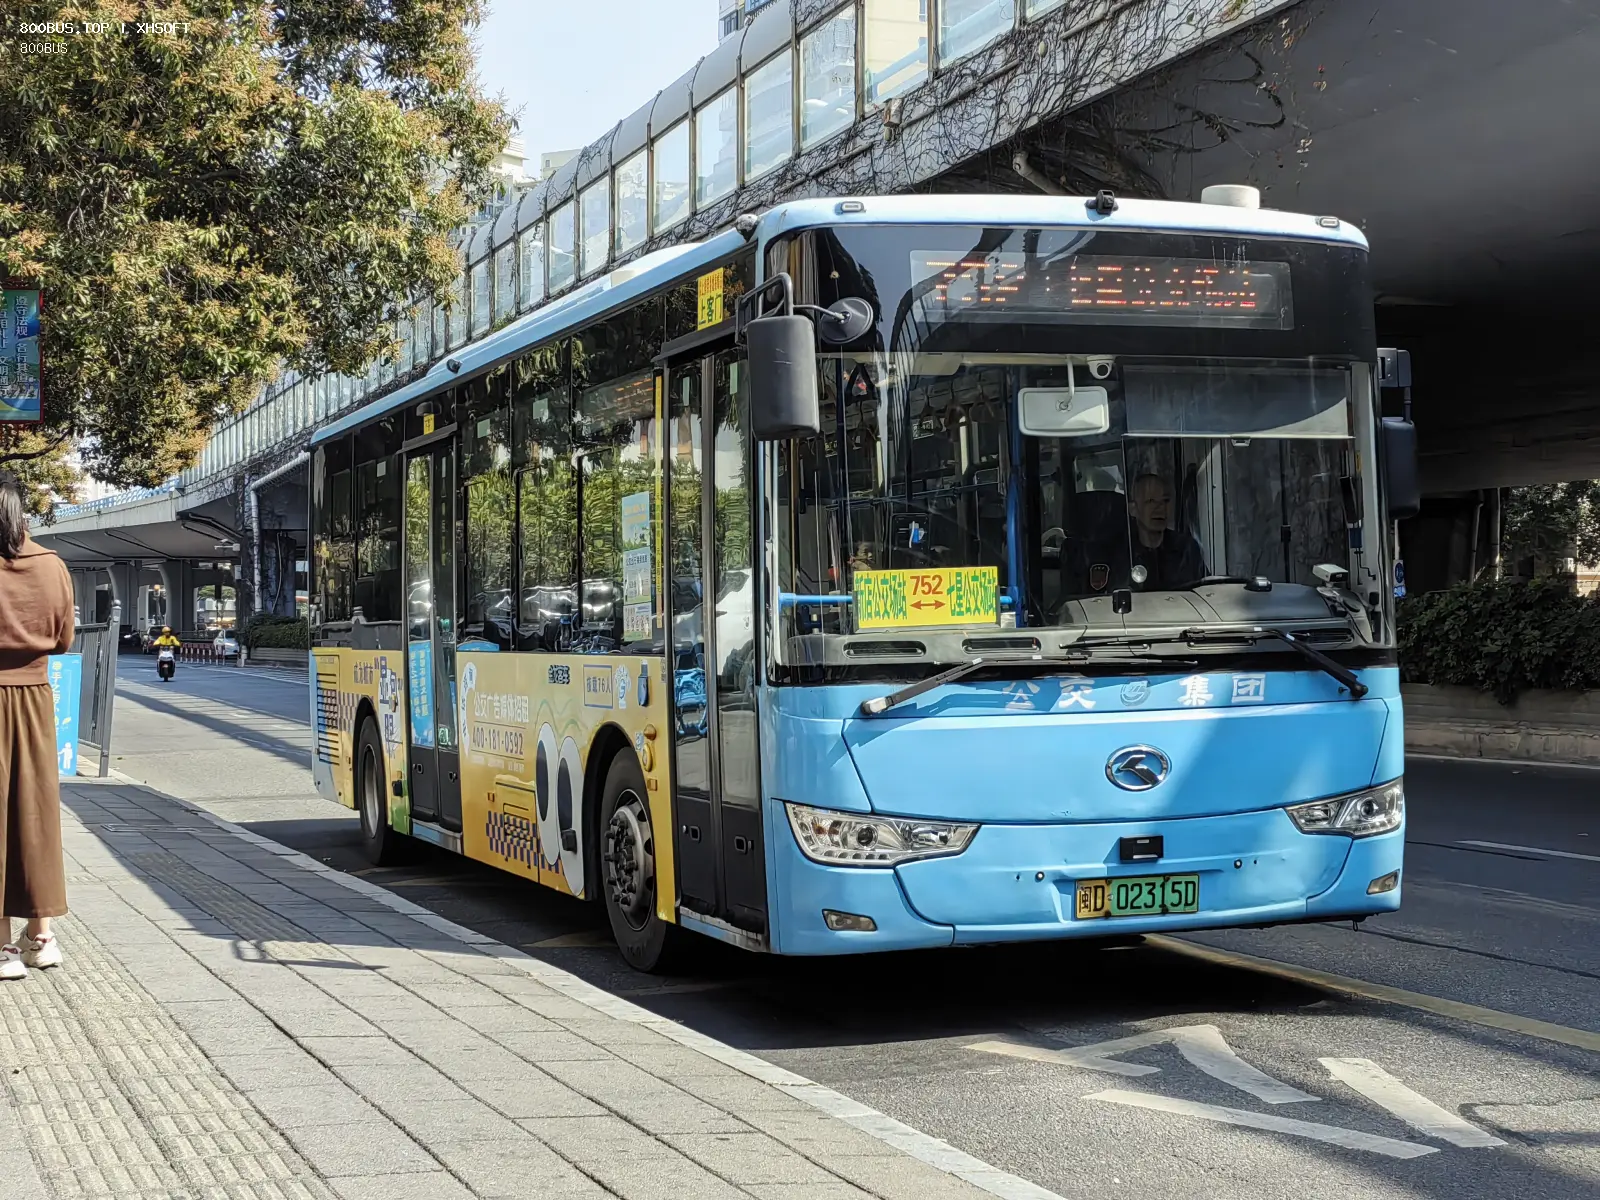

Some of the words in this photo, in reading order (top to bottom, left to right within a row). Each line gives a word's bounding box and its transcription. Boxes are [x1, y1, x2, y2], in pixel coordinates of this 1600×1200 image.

[15, 295, 28, 336] 遵守法规
[909, 574, 943, 596] 752
[1002, 674, 1096, 709] 公交
[1177, 674, 1266, 706] 集团
[1080, 884, 1105, 913] 闽D
[1116, 880, 1197, 910] 02315D
